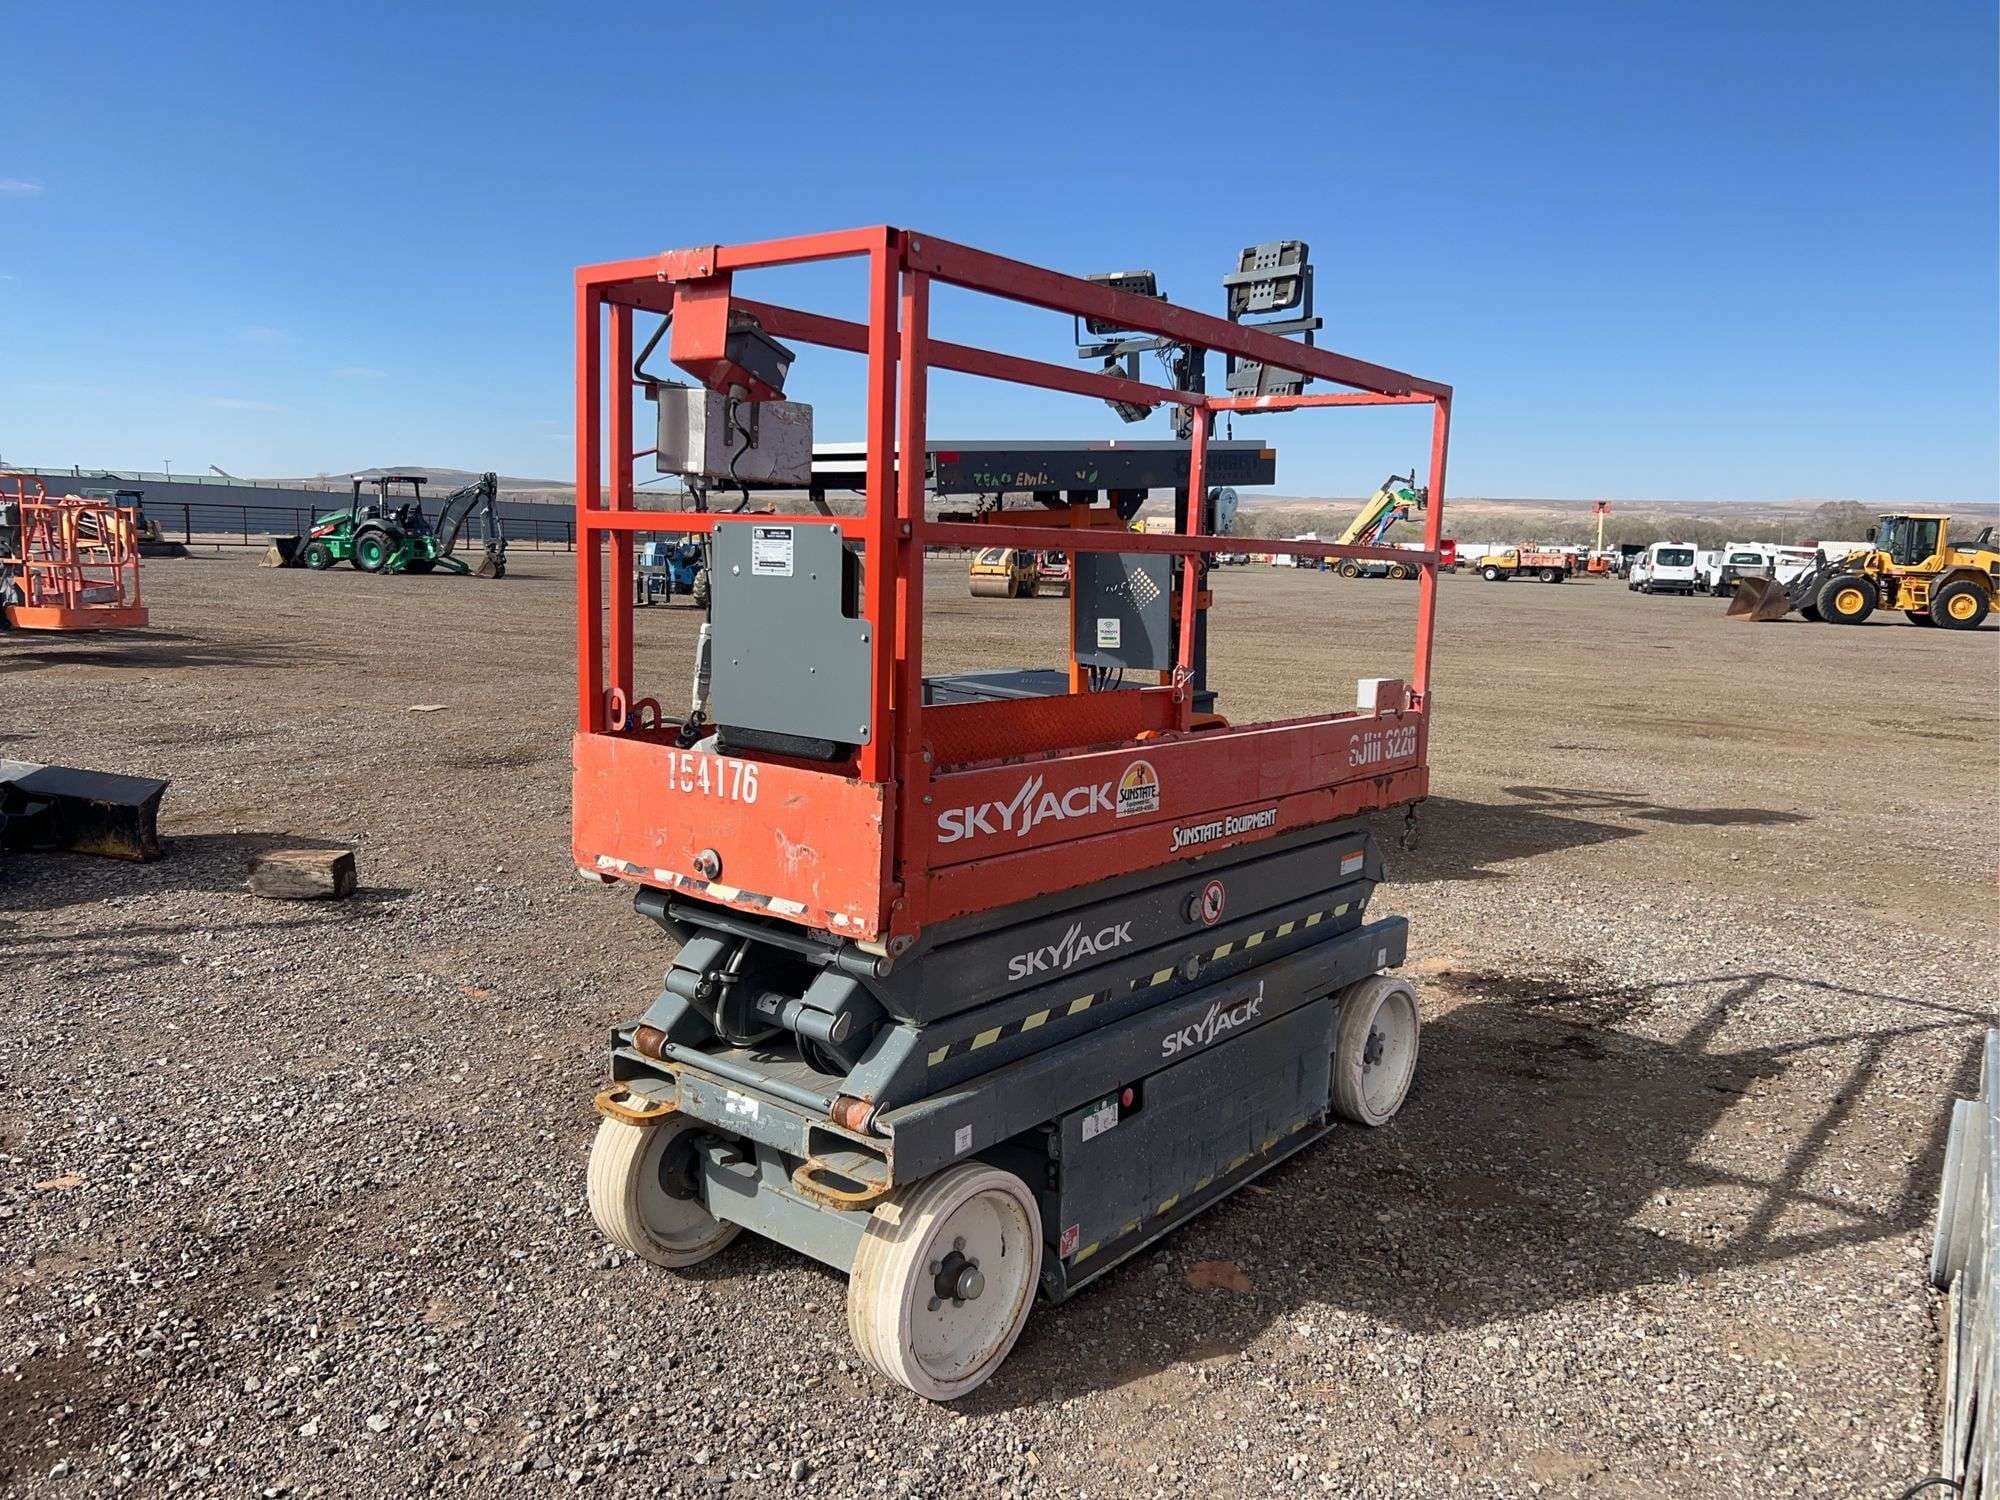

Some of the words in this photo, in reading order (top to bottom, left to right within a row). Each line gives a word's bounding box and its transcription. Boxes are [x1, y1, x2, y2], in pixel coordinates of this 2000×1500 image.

[667, 751, 759, 804] 154176
[1118, 784, 1156, 803] SUNSTATE
[937, 773, 1115, 843] SKYJACK
[1007, 920, 1134, 981] SKYJACK
[1161, 1000, 1263, 1058] SKYJACK
